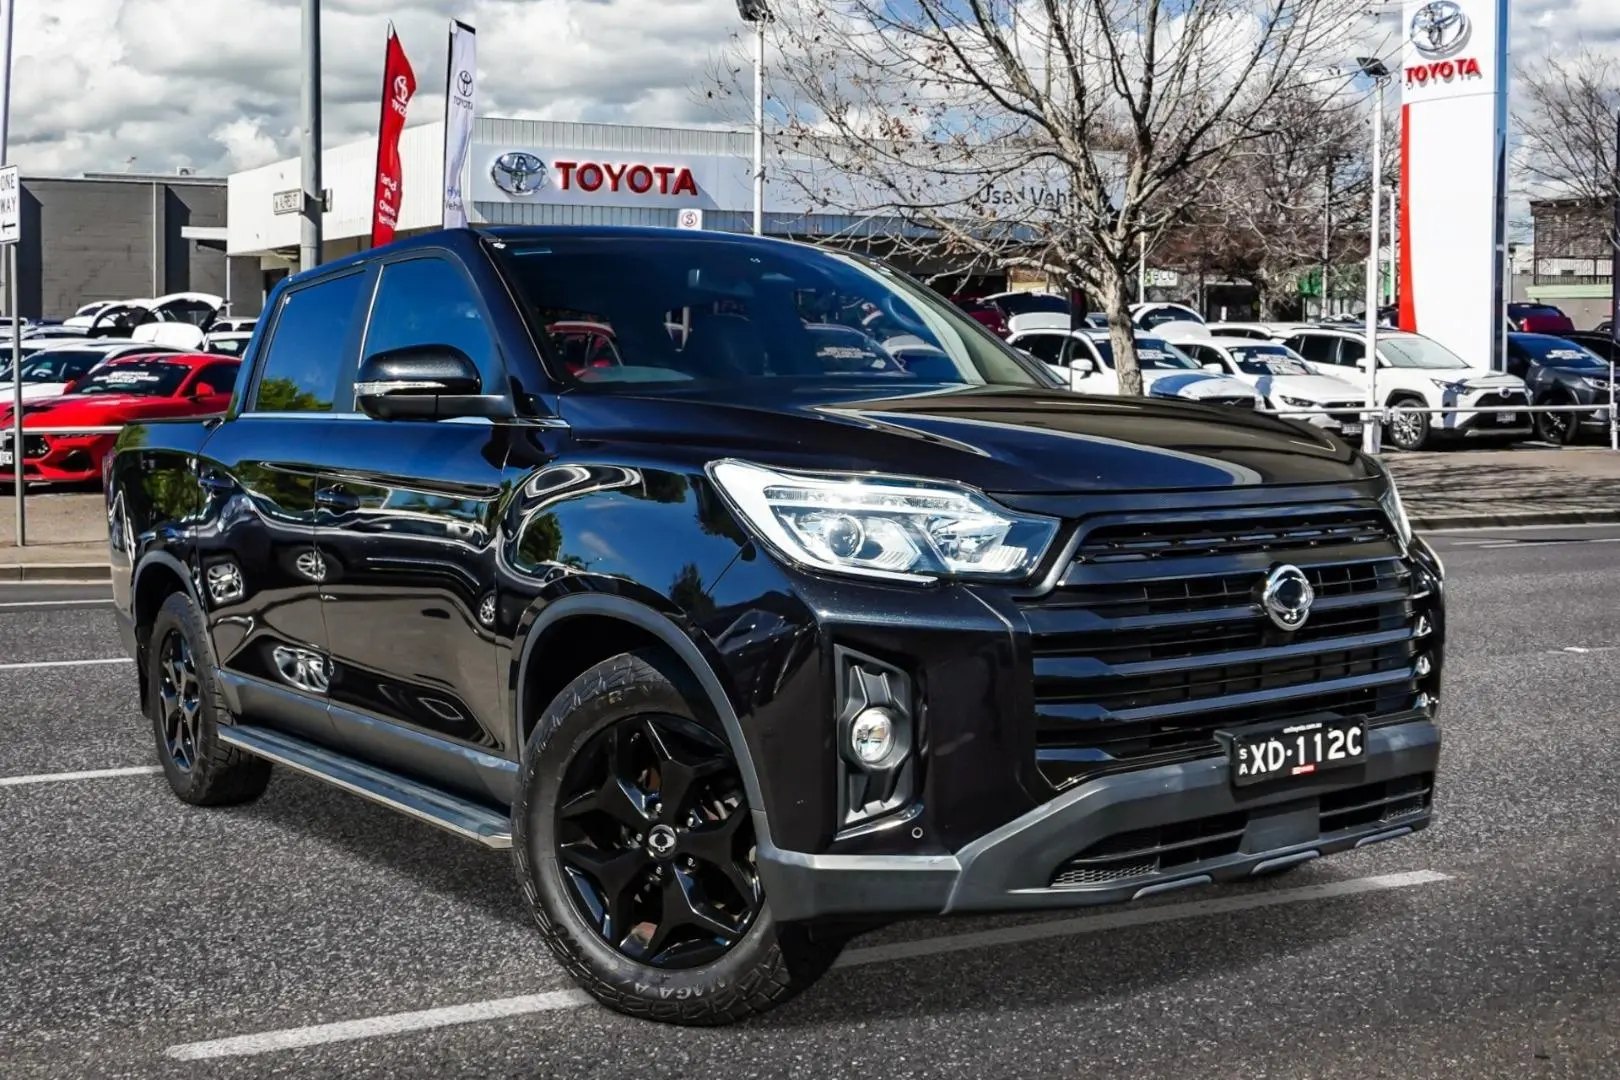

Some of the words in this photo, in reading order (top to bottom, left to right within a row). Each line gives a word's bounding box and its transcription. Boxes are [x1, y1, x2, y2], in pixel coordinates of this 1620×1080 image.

[1404, 58, 1481, 84] TOYOTA
[1, 172, 15, 191] ONE
[555, 161, 698, 196] TOYOTA
[1, 196, 16, 215] WAY
